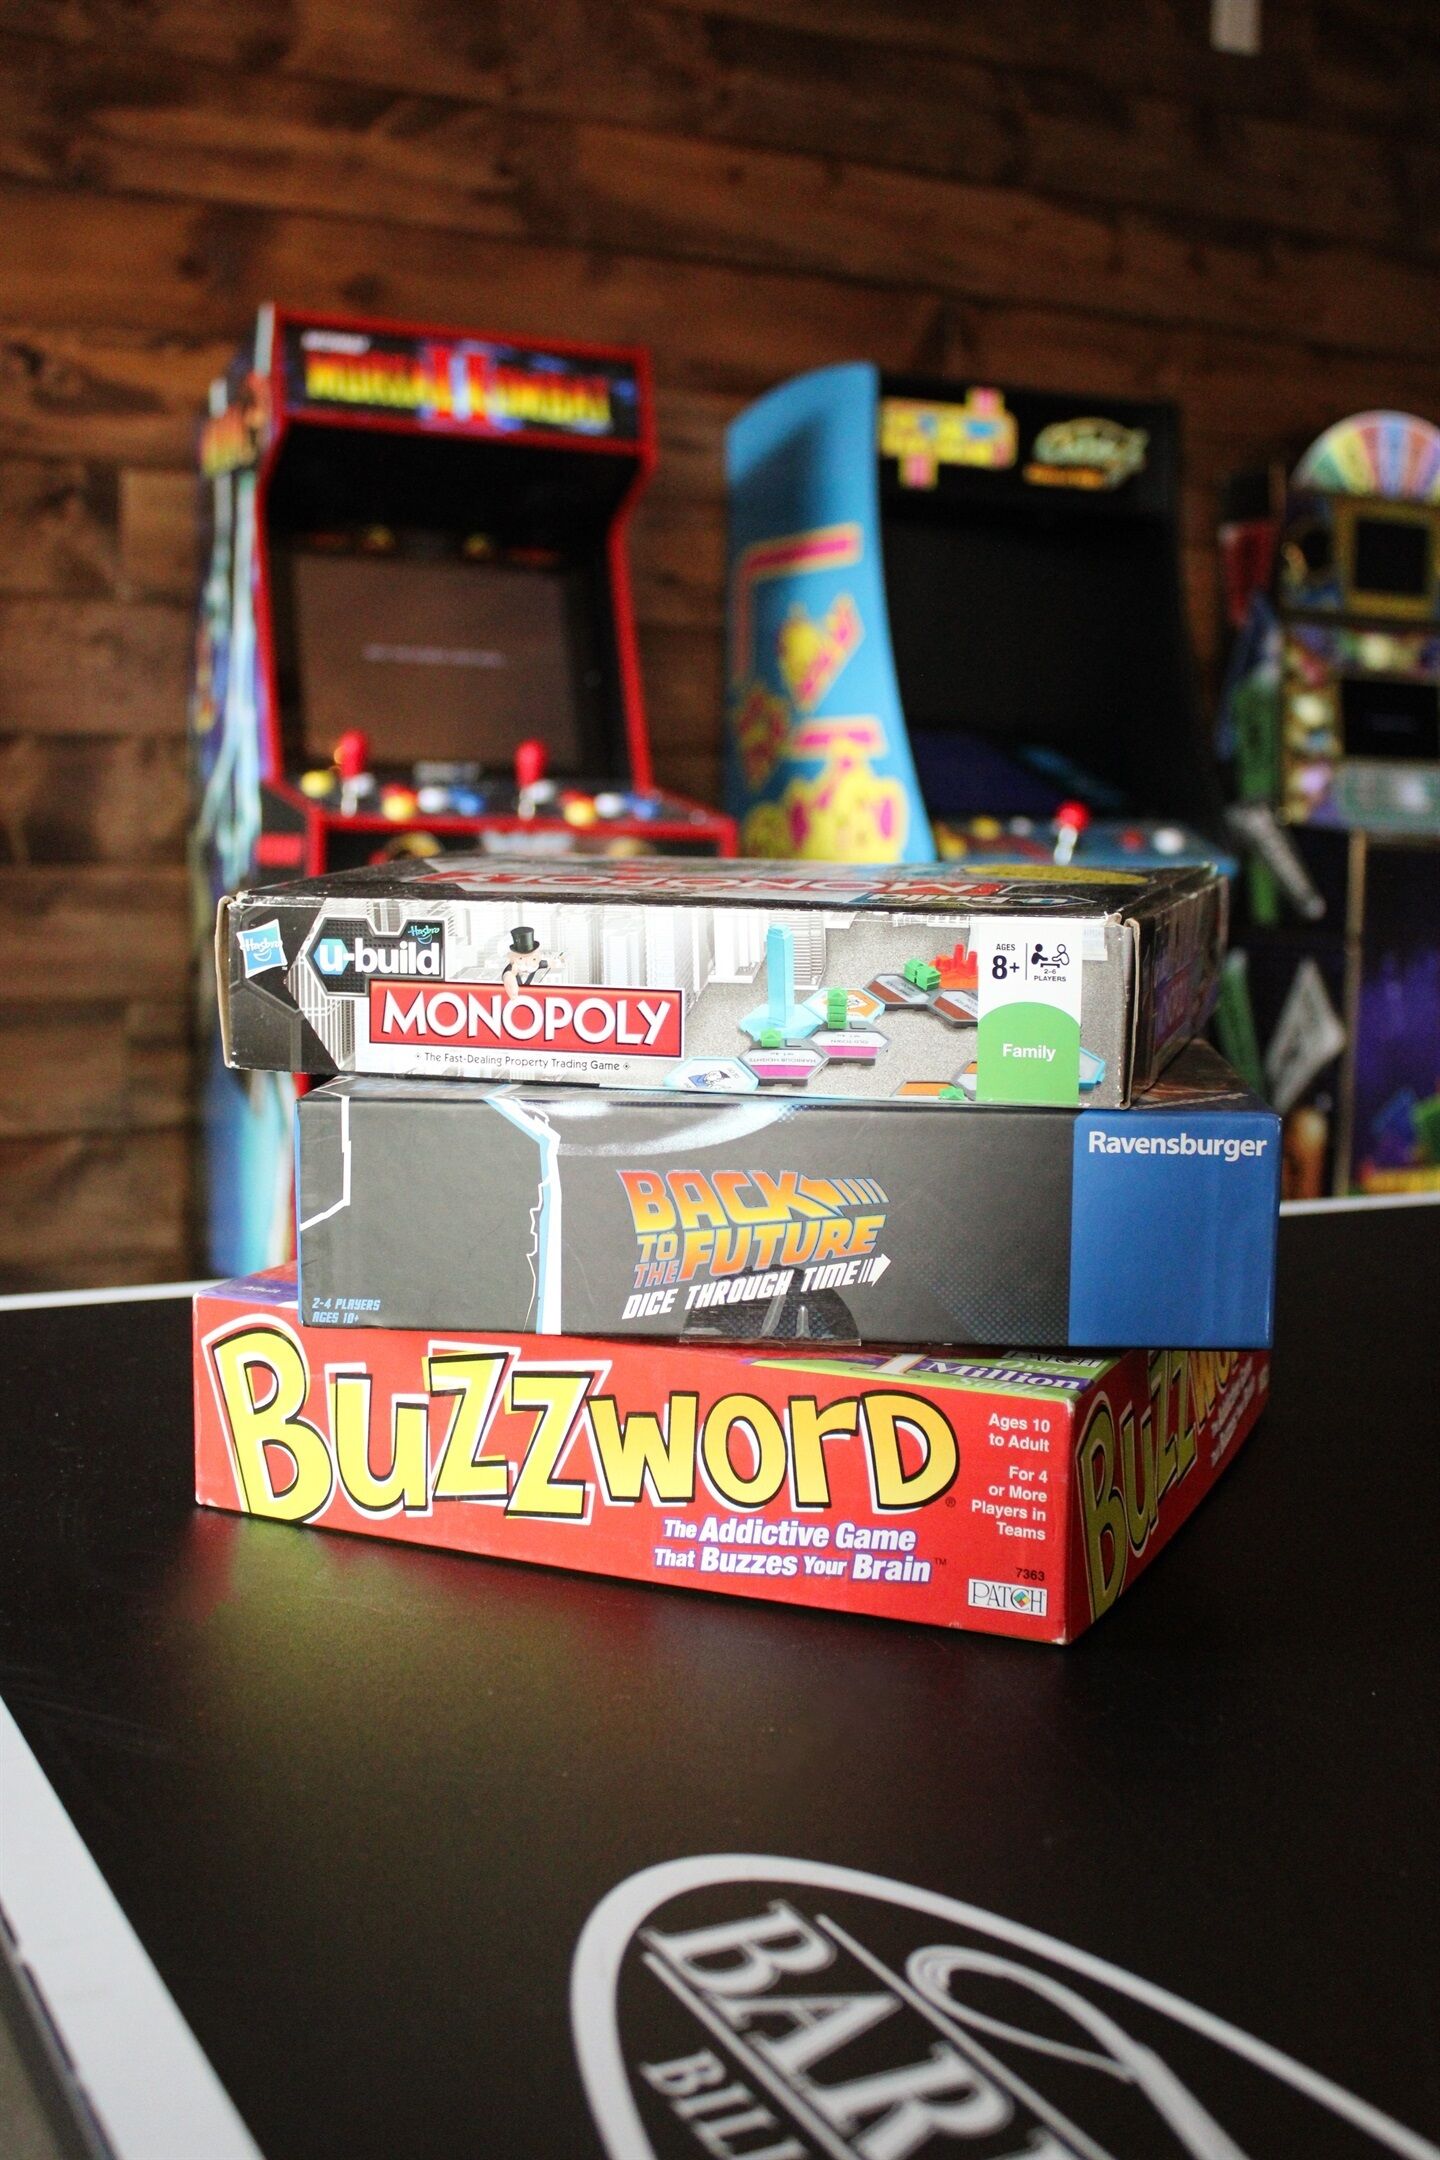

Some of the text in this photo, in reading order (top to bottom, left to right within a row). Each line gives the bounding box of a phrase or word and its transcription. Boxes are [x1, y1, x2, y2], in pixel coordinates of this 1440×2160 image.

[408, 925, 440, 938] Hasbro
[996, 943, 1016, 951] AGES
[992, 955, 1020, 980] 8+
[381, 989, 672, 1045] MONOPOLY
[425, 1052, 620, 1071] The Fast-Dealing Property Trading Game
[1002, 1043, 1056, 1062] Family
[1088, 1131, 1268, 1162] Ravensburger
[617, 1169, 843, 1233] BACK
[637, 1233, 678, 1262] TO
[678, 1215, 887, 1281] FUTURE
[633, 1261, 679, 1289] THE
[622, 1260, 861, 1320] DICE THROUGH TIME
[312, 1297, 381, 1311] 2-4 PLAYERS
[312, 1311, 360, 1324] AGES 10+
[920, 1361, 1081, 1391] Million
[995, 1360, 1076, 1374] Over
[989, 1413, 1051, 1433] Ages 10
[989, 1433, 1050, 1452] to Adult
[1009, 1466, 1048, 1483] For 4
[988, 1485, 1048, 1503] or More
[971, 1500, 1046, 1521] Players in
[664, 1517, 916, 1551] The Addictive Game
[996, 1521, 1046, 1540] Teams
[654, 1546, 932, 1582] That Buzzes Your Brain
[1015, 1567, 1045, 1582] 7363
[972, 1581, 1045, 1614] PATCH
[638, 1897, 1088, 2160] BAR
